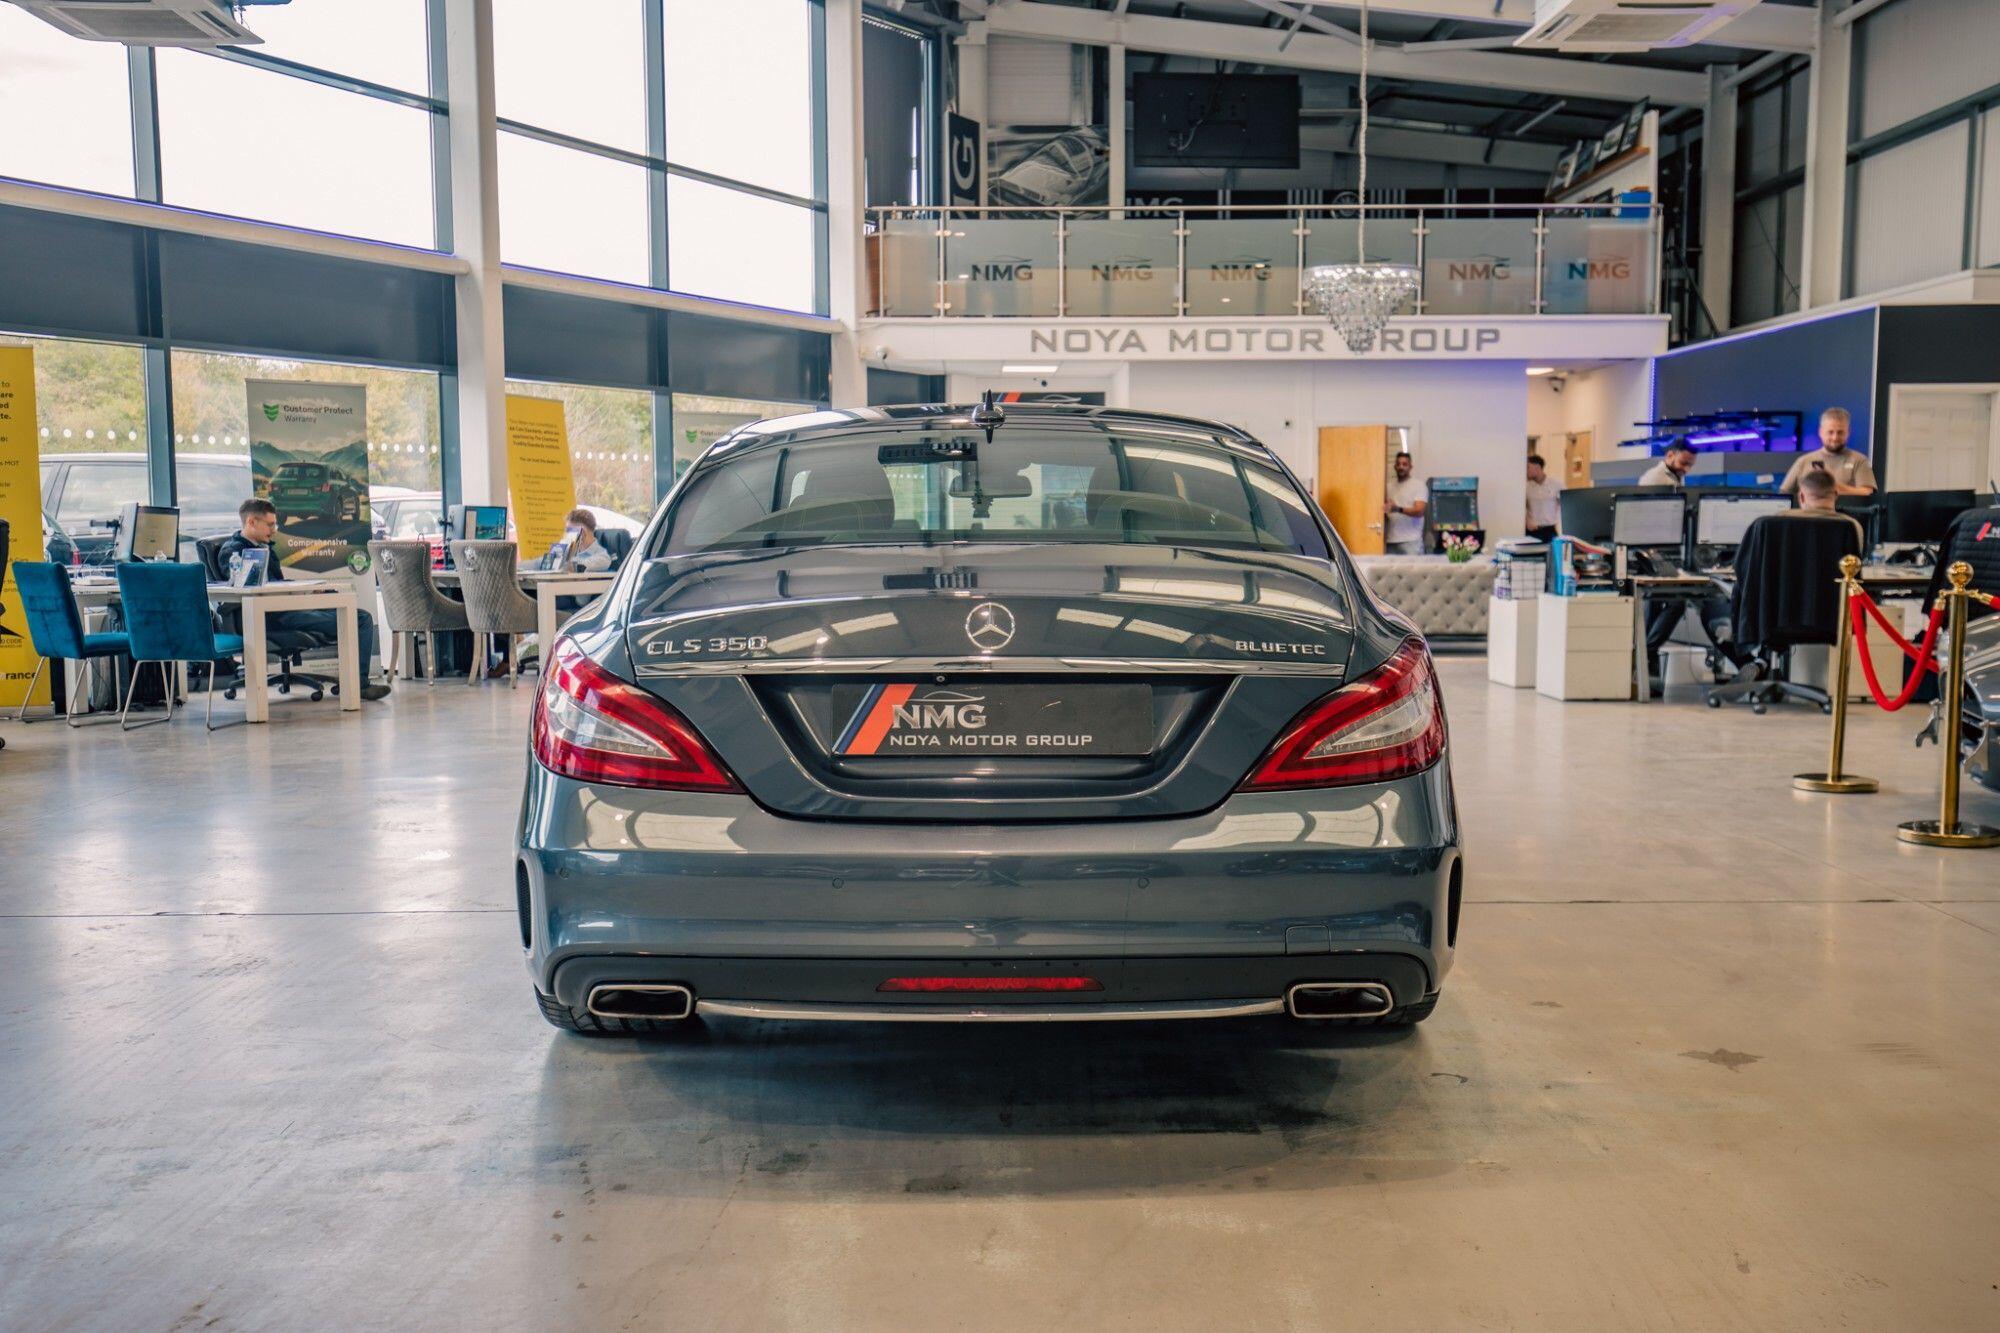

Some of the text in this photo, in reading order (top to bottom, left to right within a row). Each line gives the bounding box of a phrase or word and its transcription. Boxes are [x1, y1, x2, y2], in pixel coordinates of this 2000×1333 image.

[971, 264, 1033, 281] NMG
[1091, 264, 1153, 281] NMG
[1211, 264, 1273, 281] NMG
[1449, 263, 1511, 281] NMG
[1568, 262, 1630, 280] NMG
[1031, 328, 1147, 352] NOYA
[1169, 328, 1324, 352] MOTOR
[283, 404, 353, 415] Customer Protect
[284, 415, 317, 423] Warranty
[287, 538, 348, 548] Comprehensive
[646, 635, 768, 655] CLS 350
[1235, 640, 1326, 655] BLUETEC
[892, 704, 987, 730] NMG
[889, 734, 1093, 746] NOYA MOTOR GROUP
